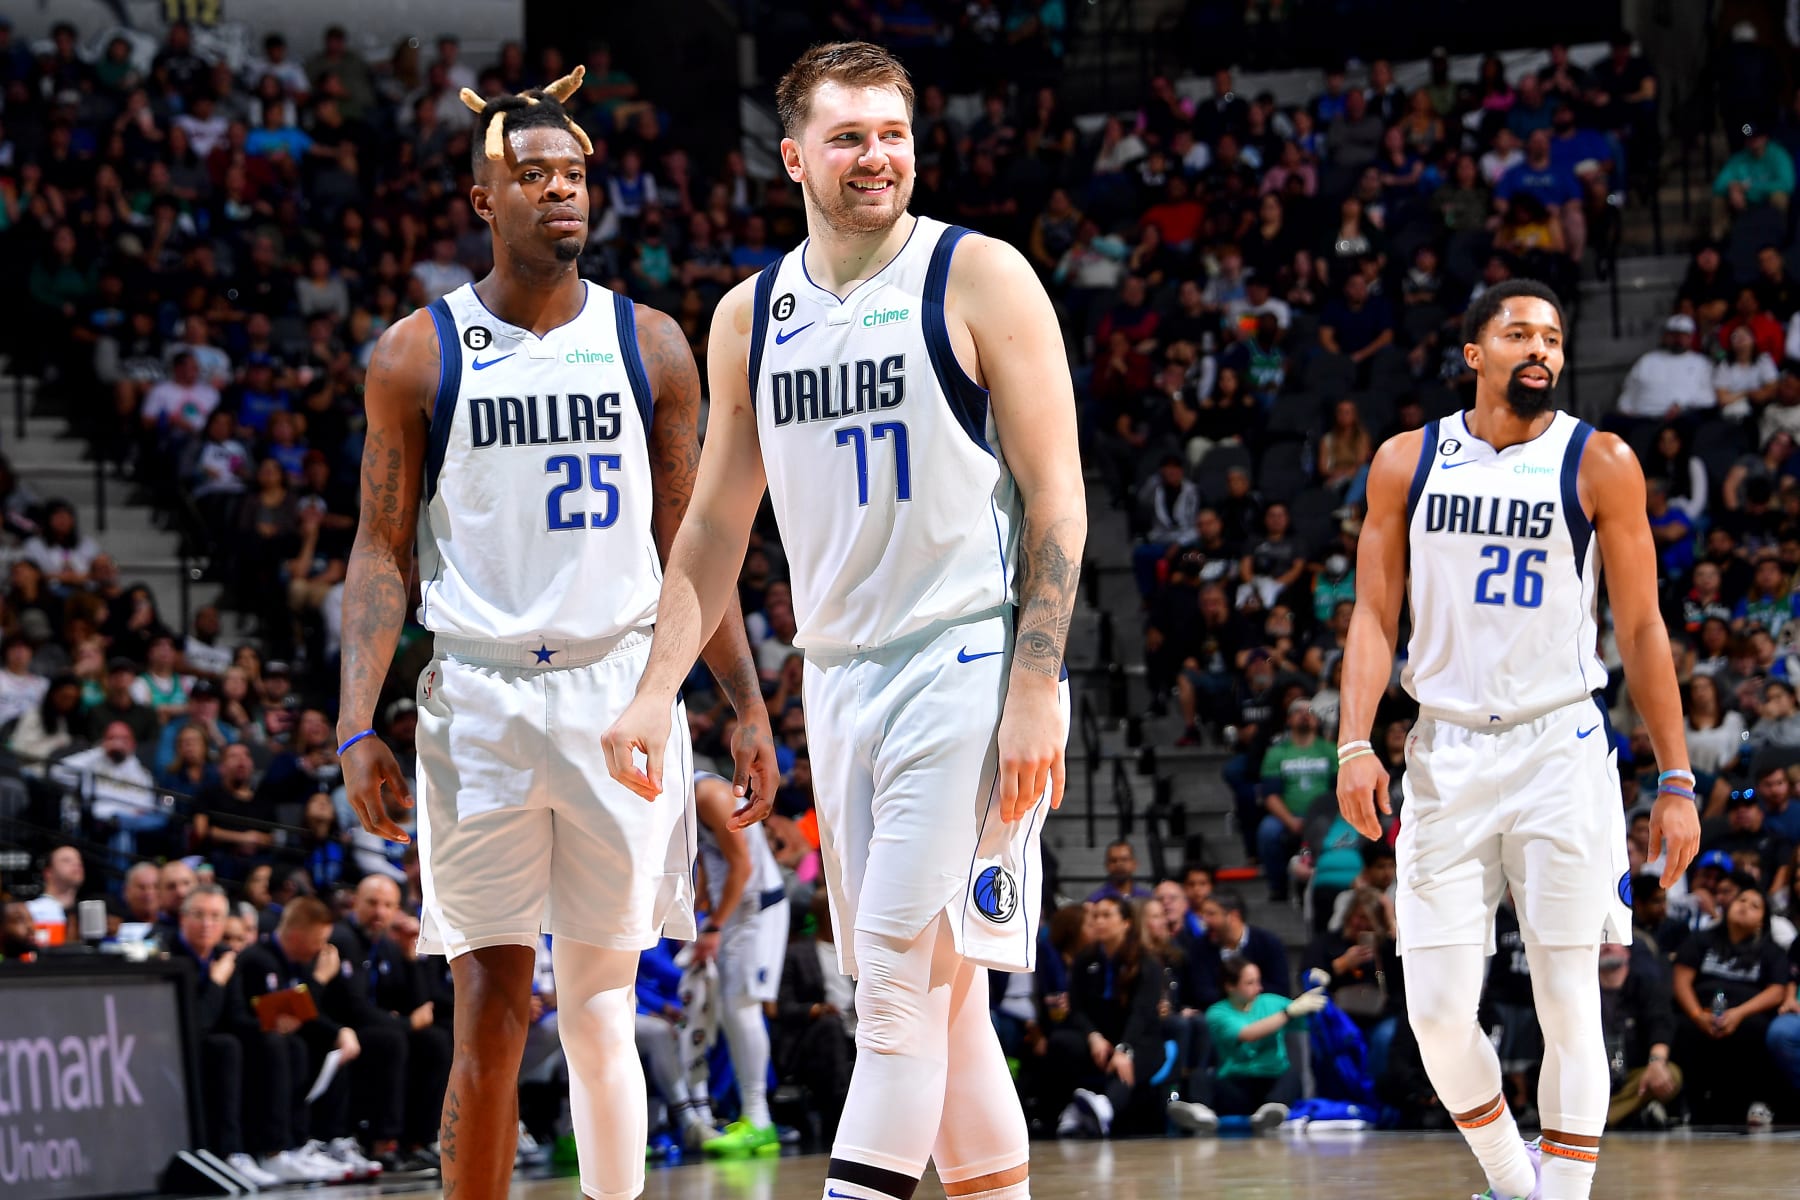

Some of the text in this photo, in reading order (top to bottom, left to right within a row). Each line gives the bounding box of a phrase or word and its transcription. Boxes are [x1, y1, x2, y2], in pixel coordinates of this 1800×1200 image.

[777, 294, 792, 320] 6
[863, 307, 909, 327] chime
[468, 329, 486, 348] 6
[565, 348, 615, 364] chime
[772, 353, 906, 428] DALLAS
[468, 391, 622, 450] DALLAS
[834, 419, 912, 507] 77
[1513, 462, 1554, 475] chime
[544, 453, 622, 532] 25
[1425, 493, 1555, 539] DALLAS
[1473, 544, 1548, 609] 26
